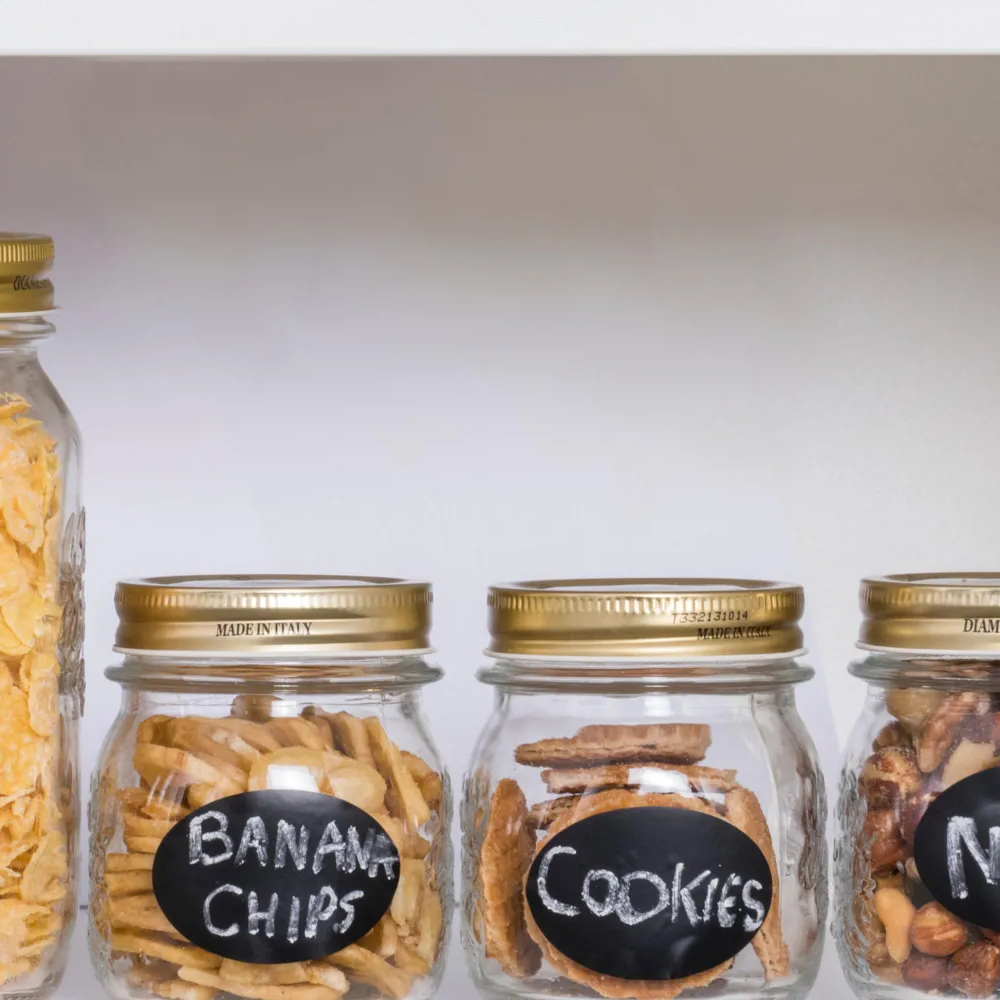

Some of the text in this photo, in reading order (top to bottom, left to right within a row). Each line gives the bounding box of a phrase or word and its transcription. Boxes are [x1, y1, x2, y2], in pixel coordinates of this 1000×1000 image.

[216, 621, 312, 637] MADE IN ITALY
[696, 625, 772, 640] MADE IN ITALY
[963, 618, 1000, 633] DIAM
[188, 810, 399, 881] BANANA
[203, 883, 364, 944] CHIPS
